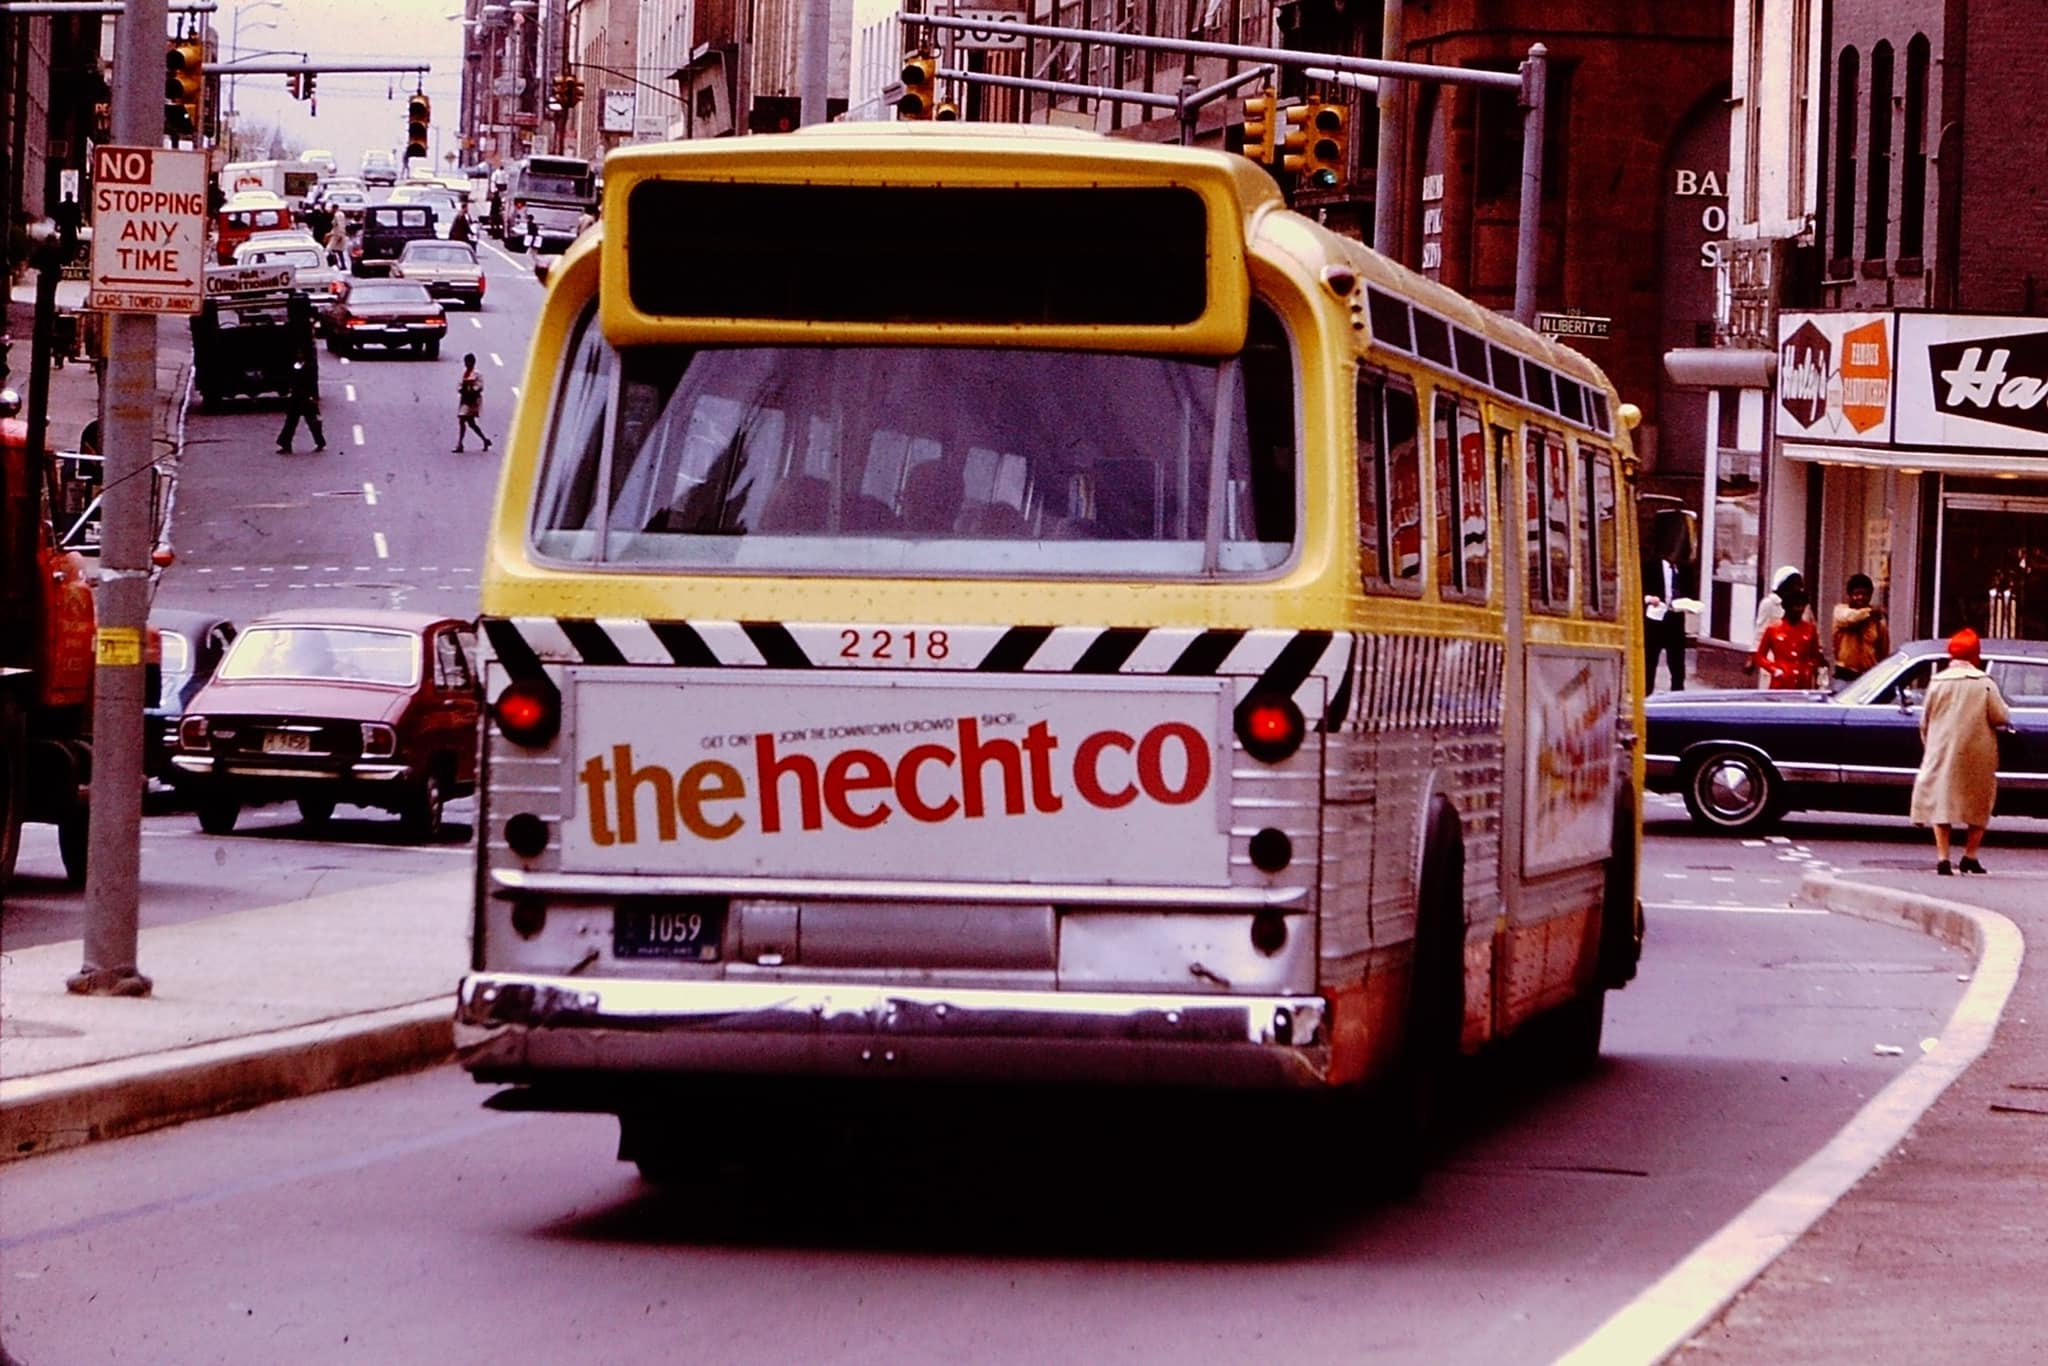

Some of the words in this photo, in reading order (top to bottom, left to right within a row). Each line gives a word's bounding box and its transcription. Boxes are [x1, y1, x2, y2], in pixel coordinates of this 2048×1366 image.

[101, 152, 145, 181] NO
[1675, 169, 1729, 197] BA
[97, 188, 202, 216] STOPPING
[121, 219, 178, 242] ANY
[117, 248, 179, 273] TIME
[96, 294, 122, 308] CARS
[127, 295, 162, 309] TOWED
[166, 297, 194, 310] AWAY
[1941, 347, 2048, 410] Ha
[840, 629, 949, 660] 2218
[701, 735, 724, 749] GET
[828, 722, 901, 739] DOWNTOWN
[579, 743, 746, 846] the
[755, 717, 1063, 833] hecht
[1073, 721, 1212, 810] co
[649, 913, 702, 942] 1059
